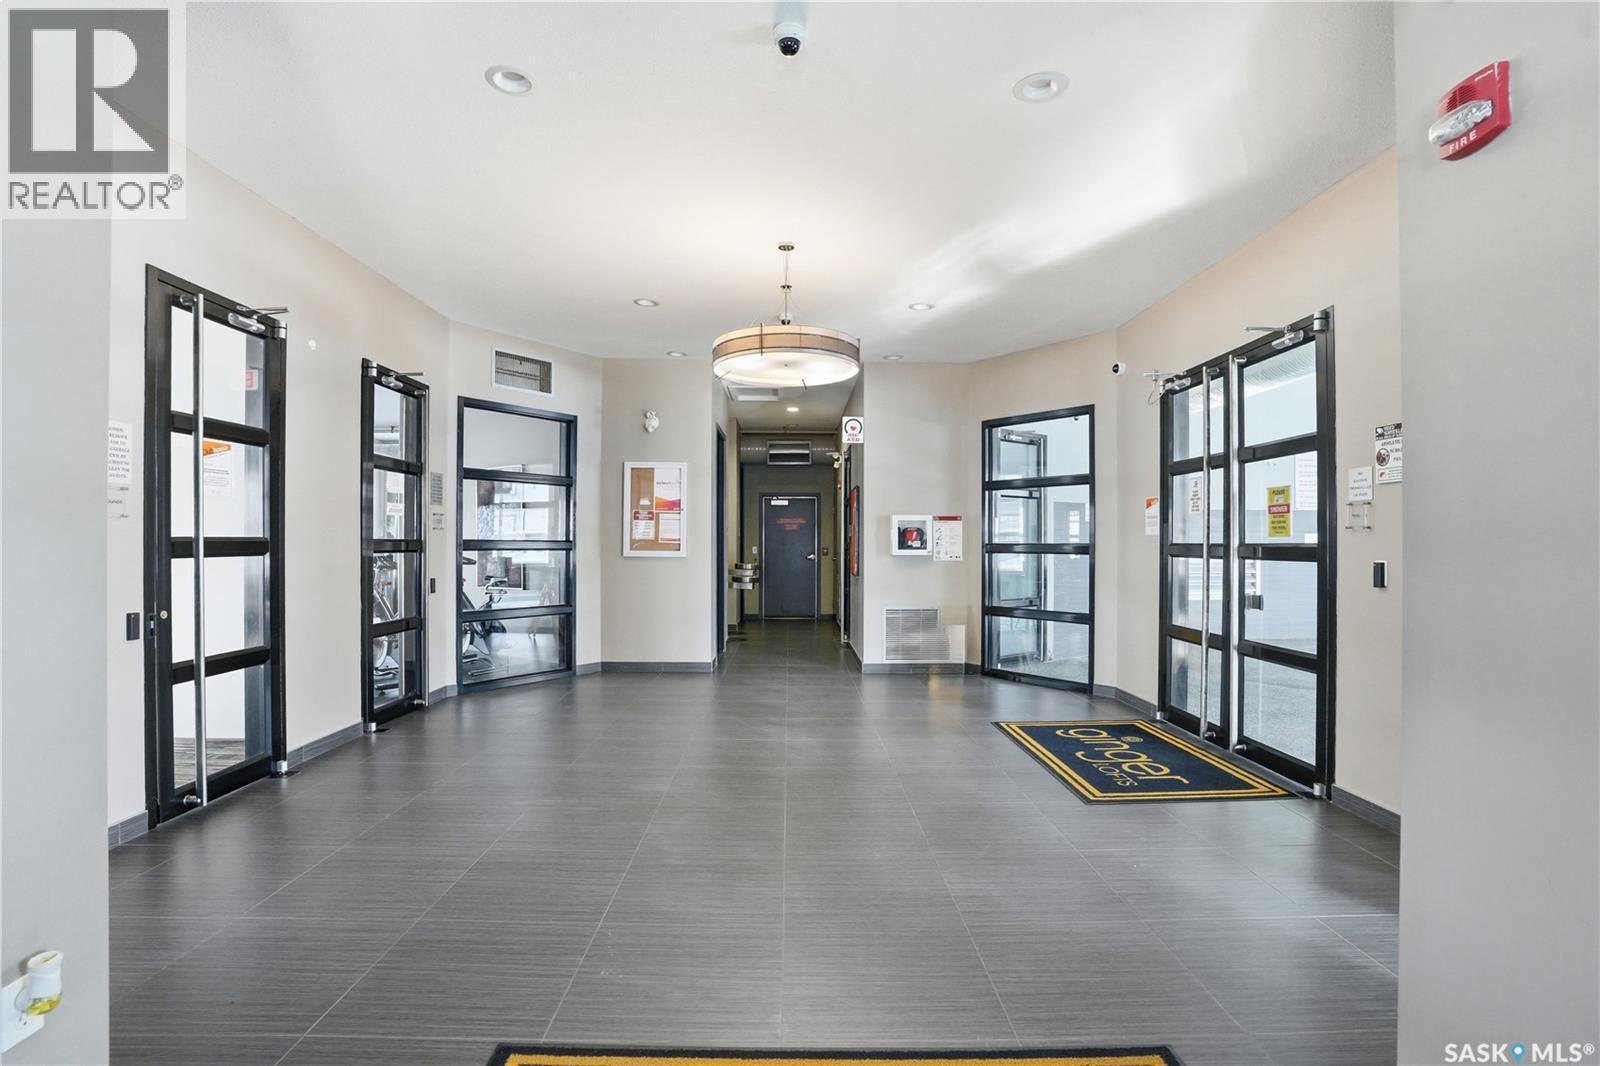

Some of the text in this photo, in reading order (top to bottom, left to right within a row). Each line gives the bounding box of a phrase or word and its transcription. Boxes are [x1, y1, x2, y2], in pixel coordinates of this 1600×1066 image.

[1449, 130, 1478, 153] FIRE
[1056, 728, 1190, 785] ginger
[1092, 763, 1138, 786] LOFTS
